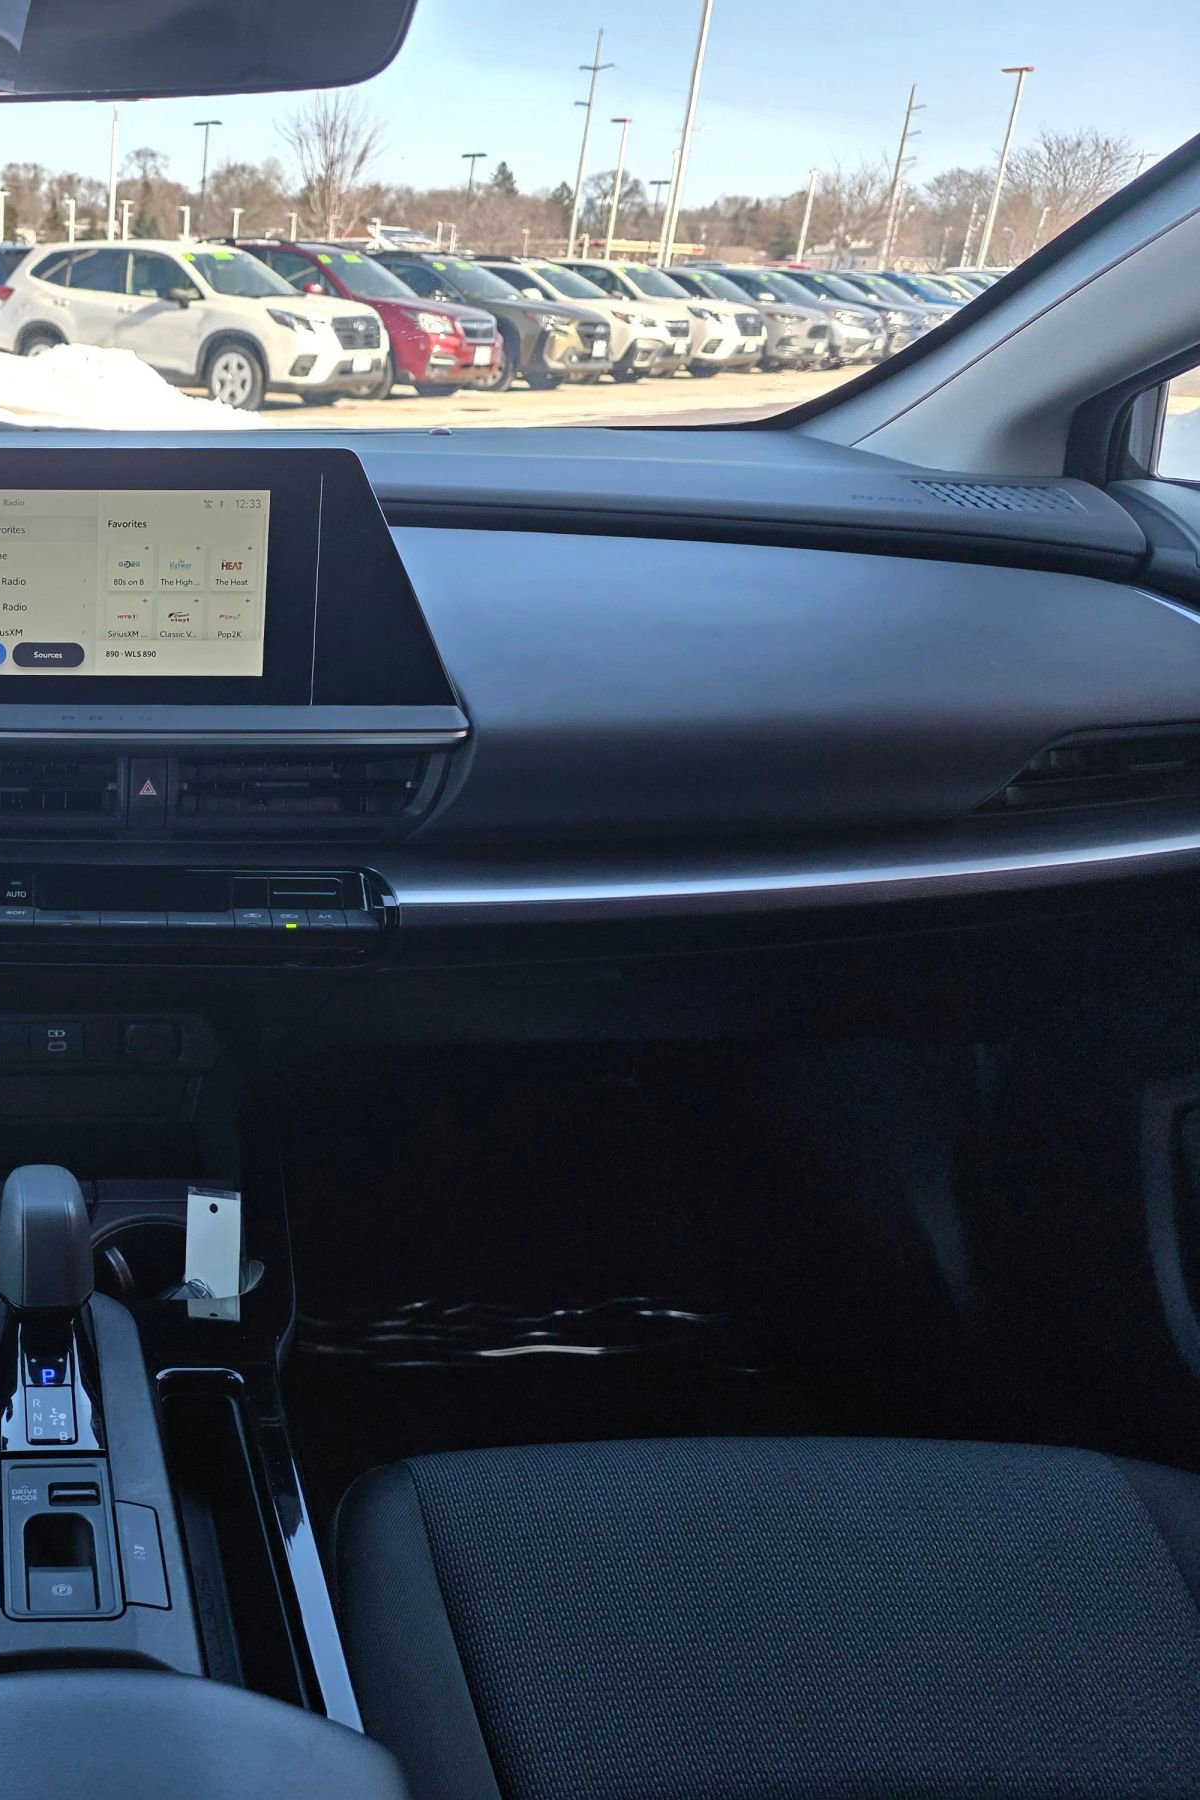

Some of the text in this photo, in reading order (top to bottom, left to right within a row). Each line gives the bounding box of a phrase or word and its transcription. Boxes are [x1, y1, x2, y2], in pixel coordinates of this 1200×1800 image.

[3, 499, 25, 507] Radio
[235, 499, 262, 509] 12:33
[107, 520, 148, 528] Favorites
[221, 561, 243, 570] HEAT
[1, 577, 27, 586] Radio
[113, 578, 127, 586] 80s
[139, 578, 145, 586] 8
[160, 578, 174, 586] The
[215, 578, 248, 586] The Heat
[2, 602, 28, 611] Radio
[159, 630, 185, 638] Classic
[217, 630, 242, 639] Pop2K
[33, 651, 63, 659] Sources
[105, 650, 157, 658] 890 WLS 890
[6, 890, 27, 898] AUTO
[41, 1368, 56, 1384] P
[32, 1398, 41, 1408] R
[32, 1412, 42, 1421] N
[33, 1426, 43, 1436] D
[59, 1431, 68, 1441] B
